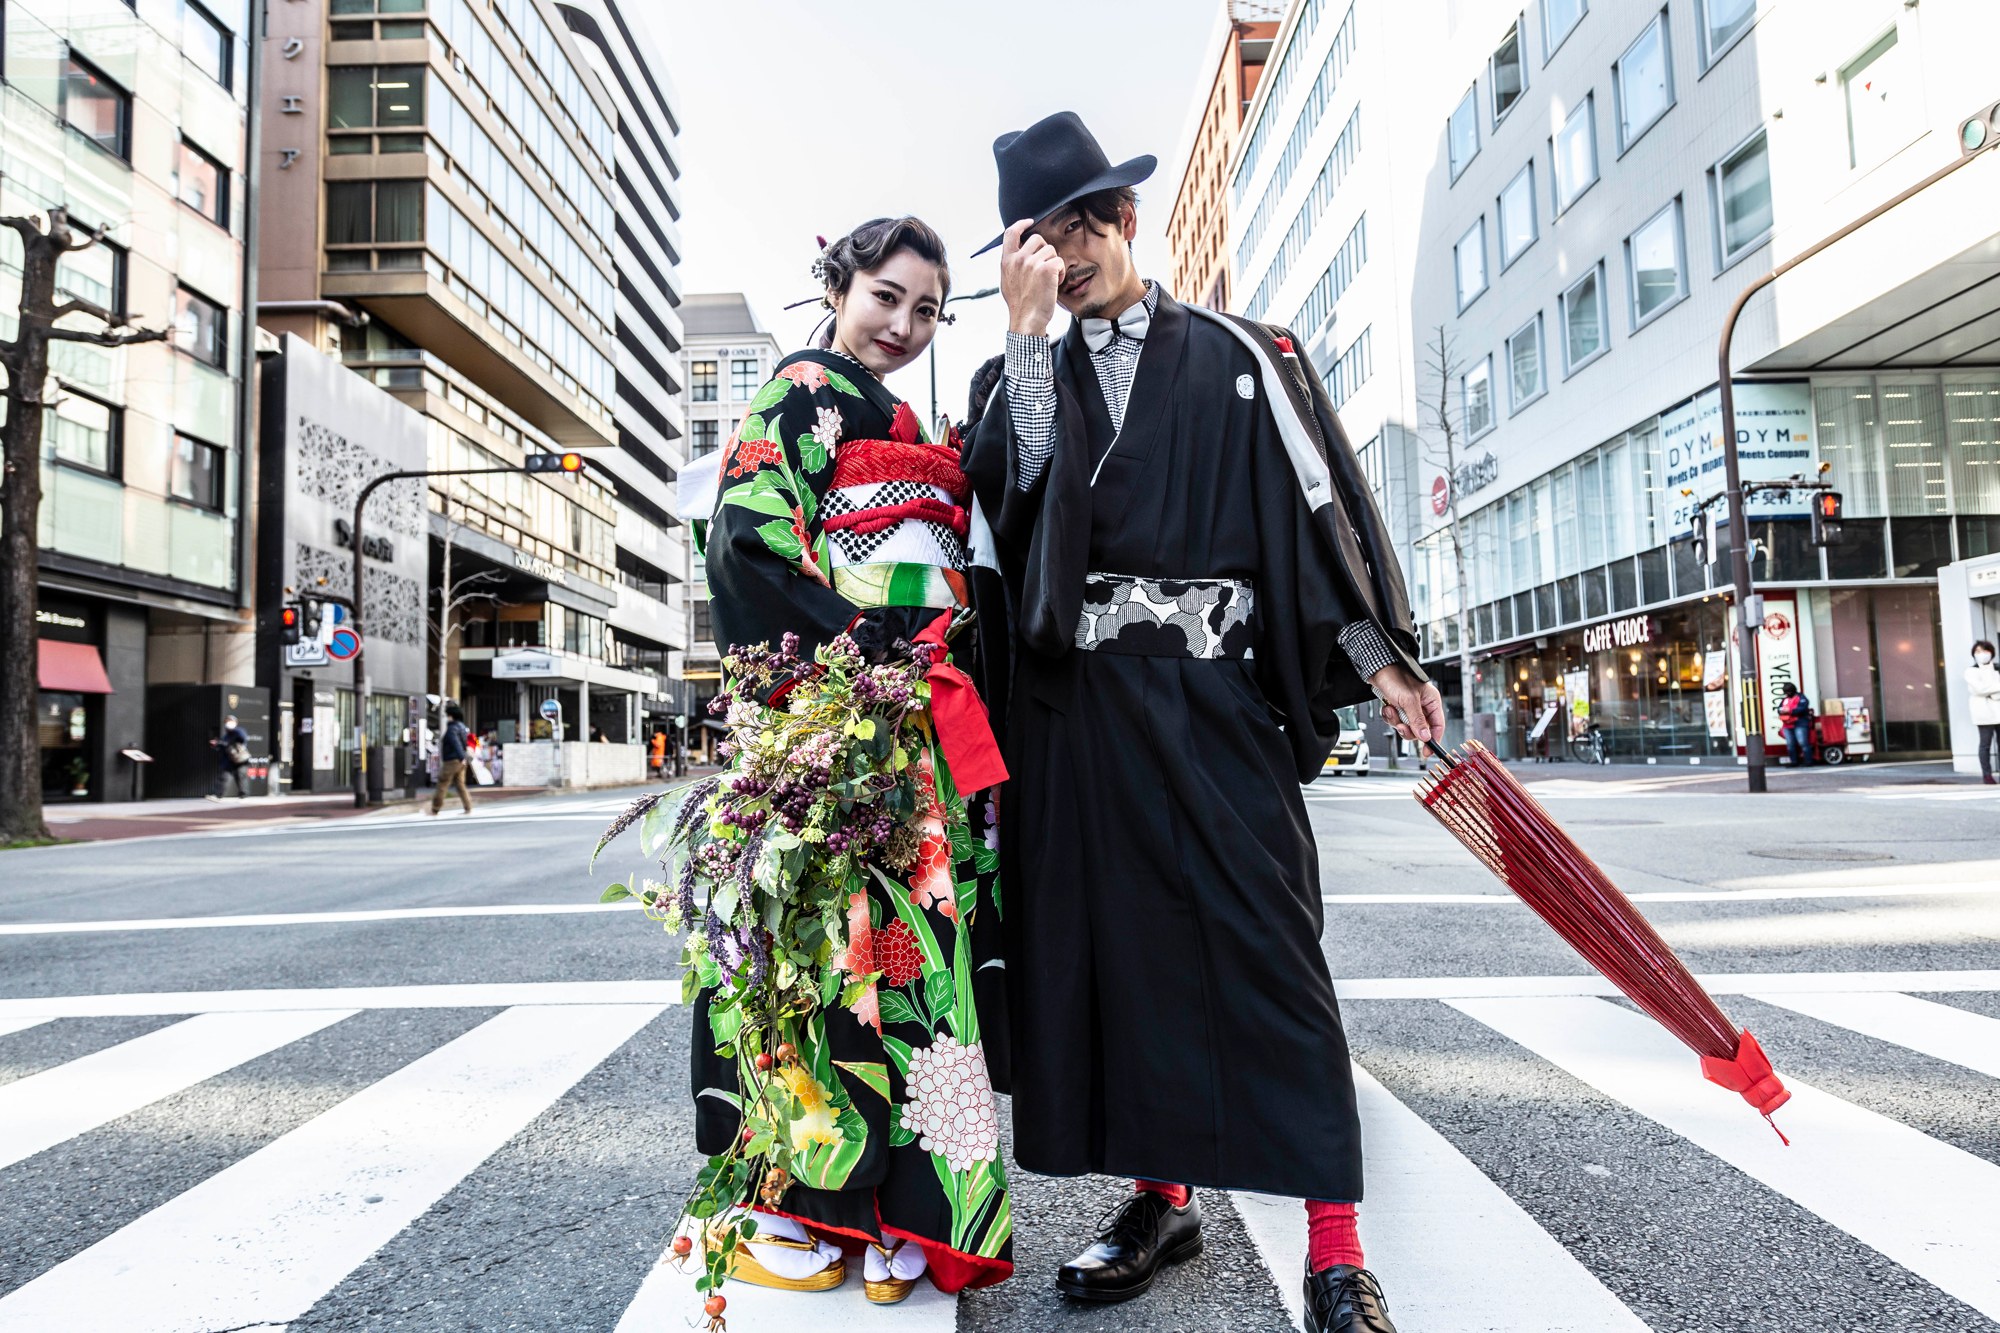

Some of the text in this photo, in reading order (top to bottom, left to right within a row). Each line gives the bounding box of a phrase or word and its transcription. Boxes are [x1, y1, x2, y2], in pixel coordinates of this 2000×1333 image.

[279, 0, 304, 170] クエア
[731, 348, 756, 356] ONLY
[1669, 431, 1712, 468] DYM
[1736, 428, 1790, 443] DYM
[1689, 456, 1727, 479] Compan
[1738, 448, 1810, 459] Meets Company
[1583, 615, 1650, 653] CAFFE VELOCE
[1770, 662, 1791, 712] VELOC
